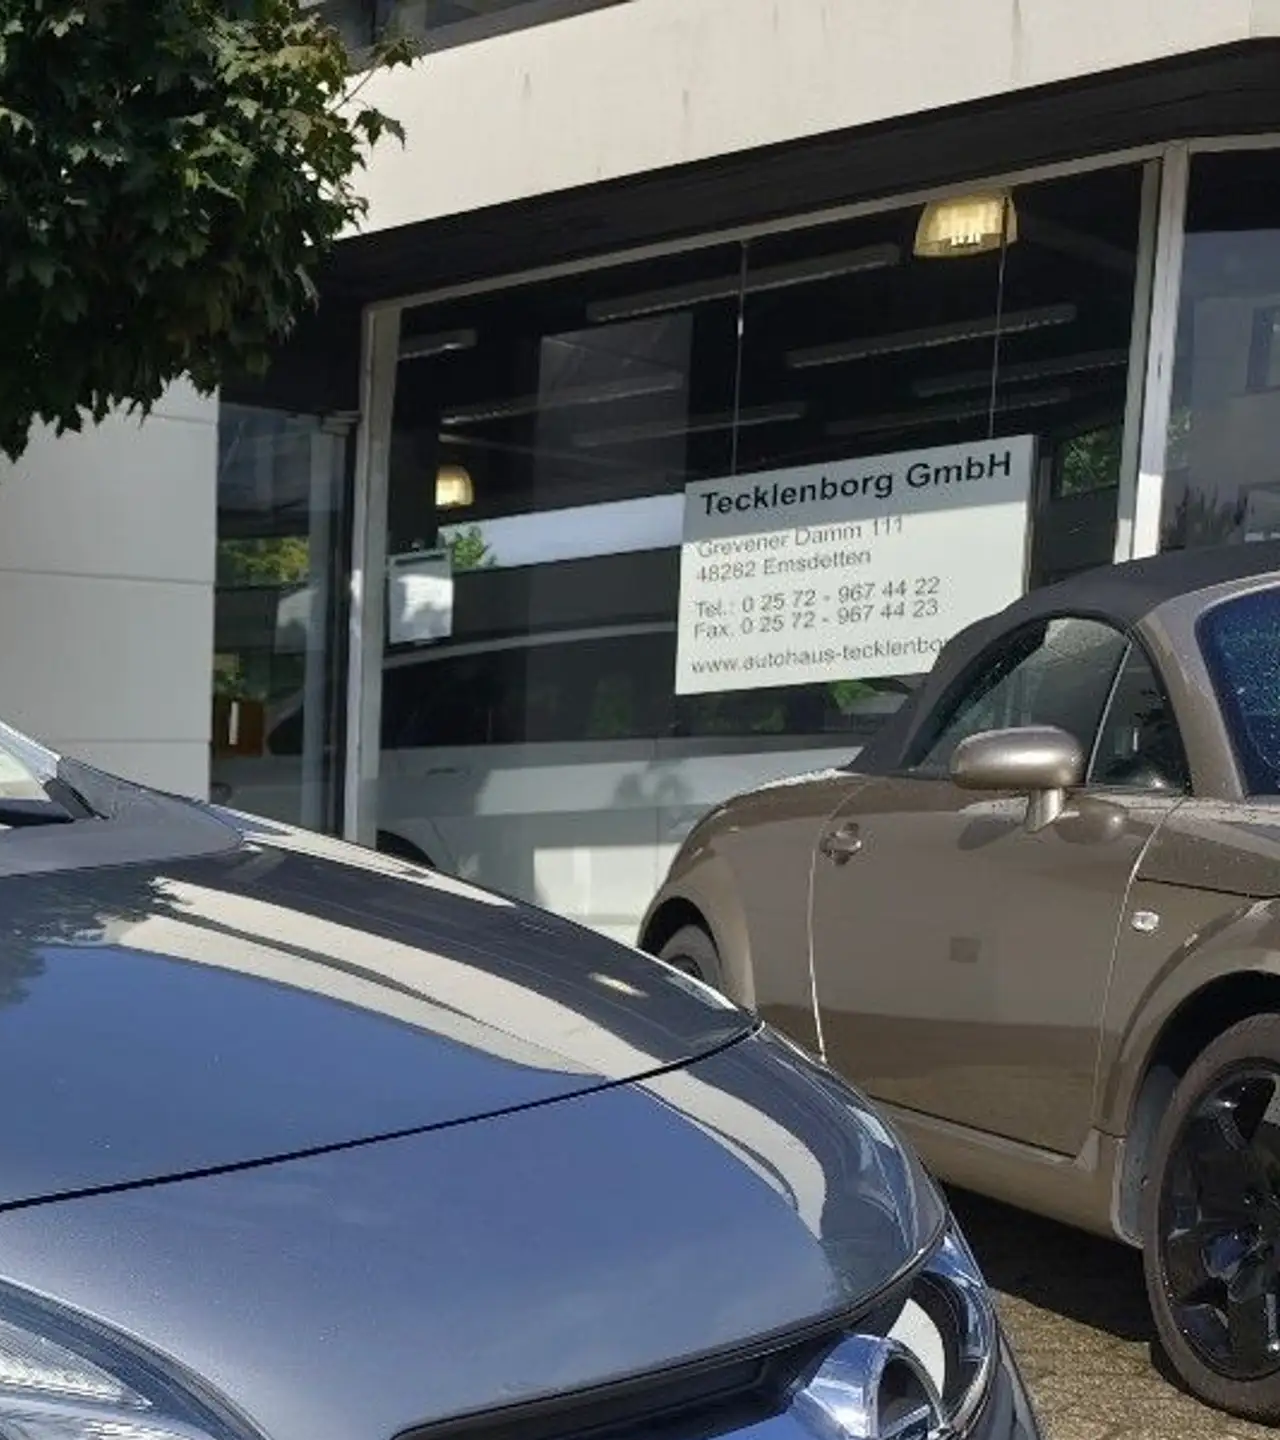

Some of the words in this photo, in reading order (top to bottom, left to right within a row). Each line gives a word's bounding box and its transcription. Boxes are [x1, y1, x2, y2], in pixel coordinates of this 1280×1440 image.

[699, 472, 893, 515] Tecklenborg
[906, 451, 1011, 488] GmbH
[697, 534, 790, 558] Grevener
[795, 525, 861, 547] Damm
[873, 515, 903, 536] 111
[764, 550, 871, 575] Emsdetten
[742, 596, 754, 613] 0
[759, 592, 785, 611] 25
[793, 589, 816, 608] 72
[838, 582, 875, 604] 967
[882, 578, 907, 598] 44
[915, 575, 940, 595] 22
[741, 616, 753, 635] 0
[759, 614, 784, 633] 25
[792, 610, 816, 630] 72
[837, 604, 874, 625] 967
[880, 601, 905, 620] 44
[913, 598, 939, 617] 23
